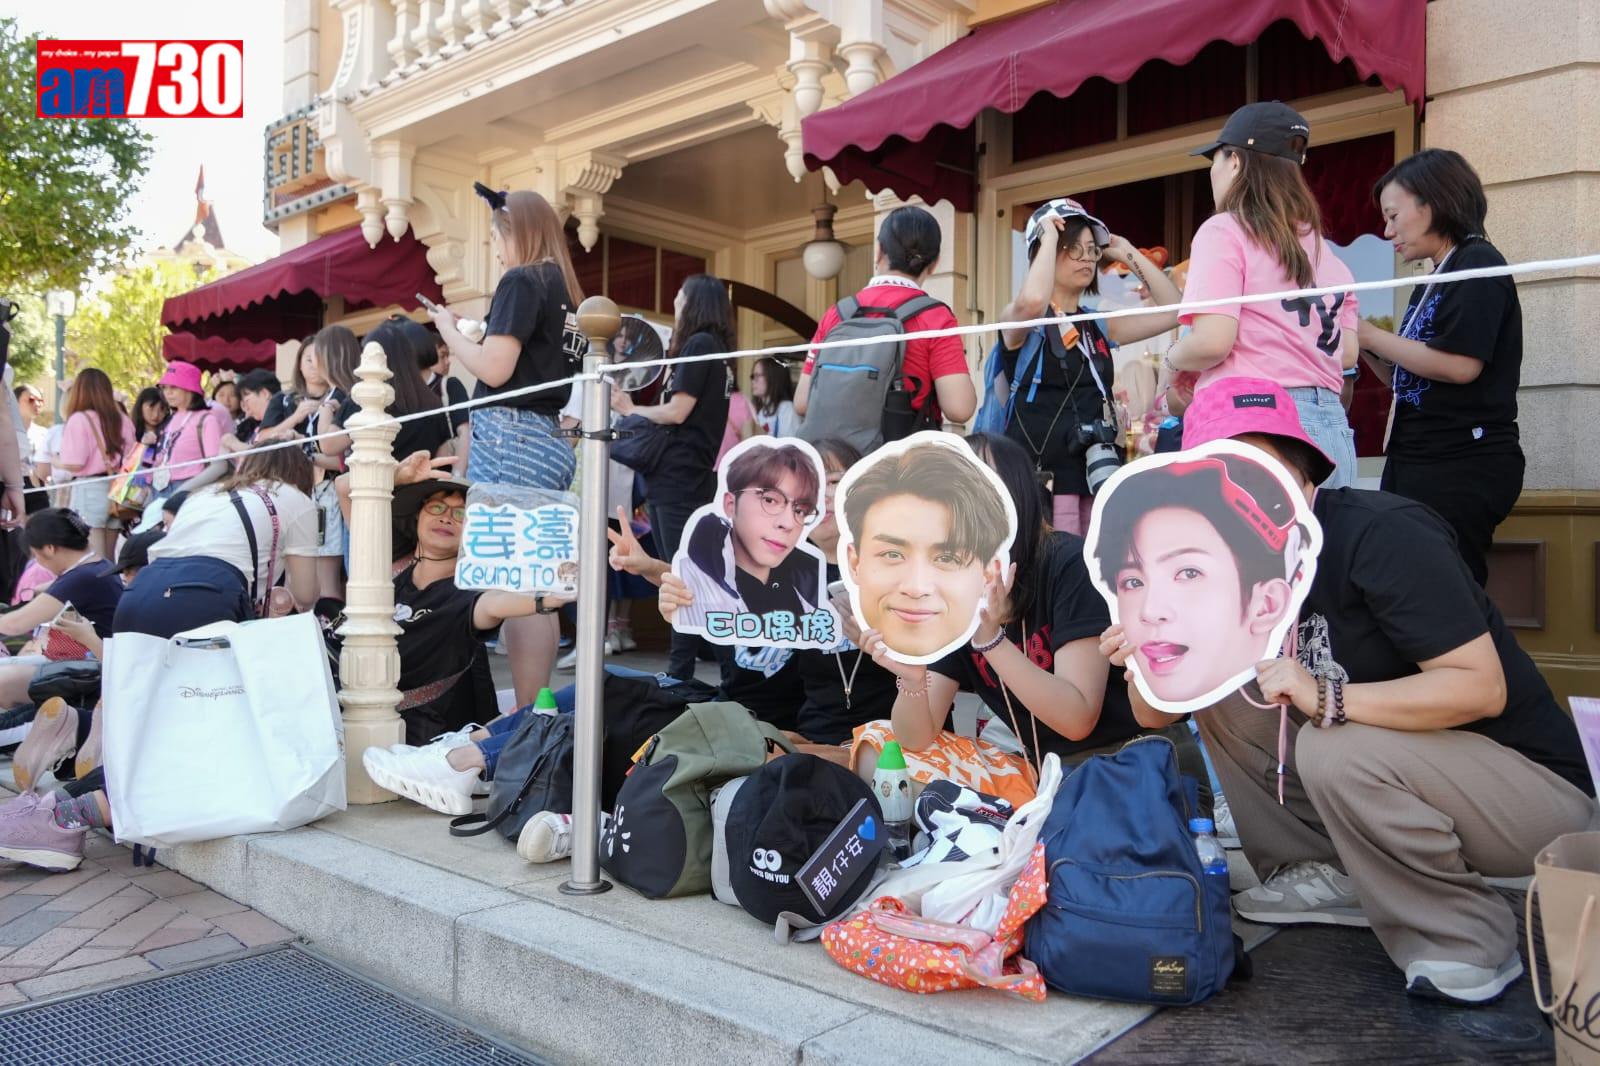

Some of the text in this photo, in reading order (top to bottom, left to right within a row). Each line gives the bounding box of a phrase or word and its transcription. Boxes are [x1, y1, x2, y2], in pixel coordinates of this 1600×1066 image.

[466, 506, 575, 560] 姜濤
[459, 562, 556, 590] Keung To
[705, 608, 836, 644] ED偶像
[764, 871, 775, 883] ON
[775, 874, 790, 884] YOU
[811, 833, 864, 901] 靚仔安
